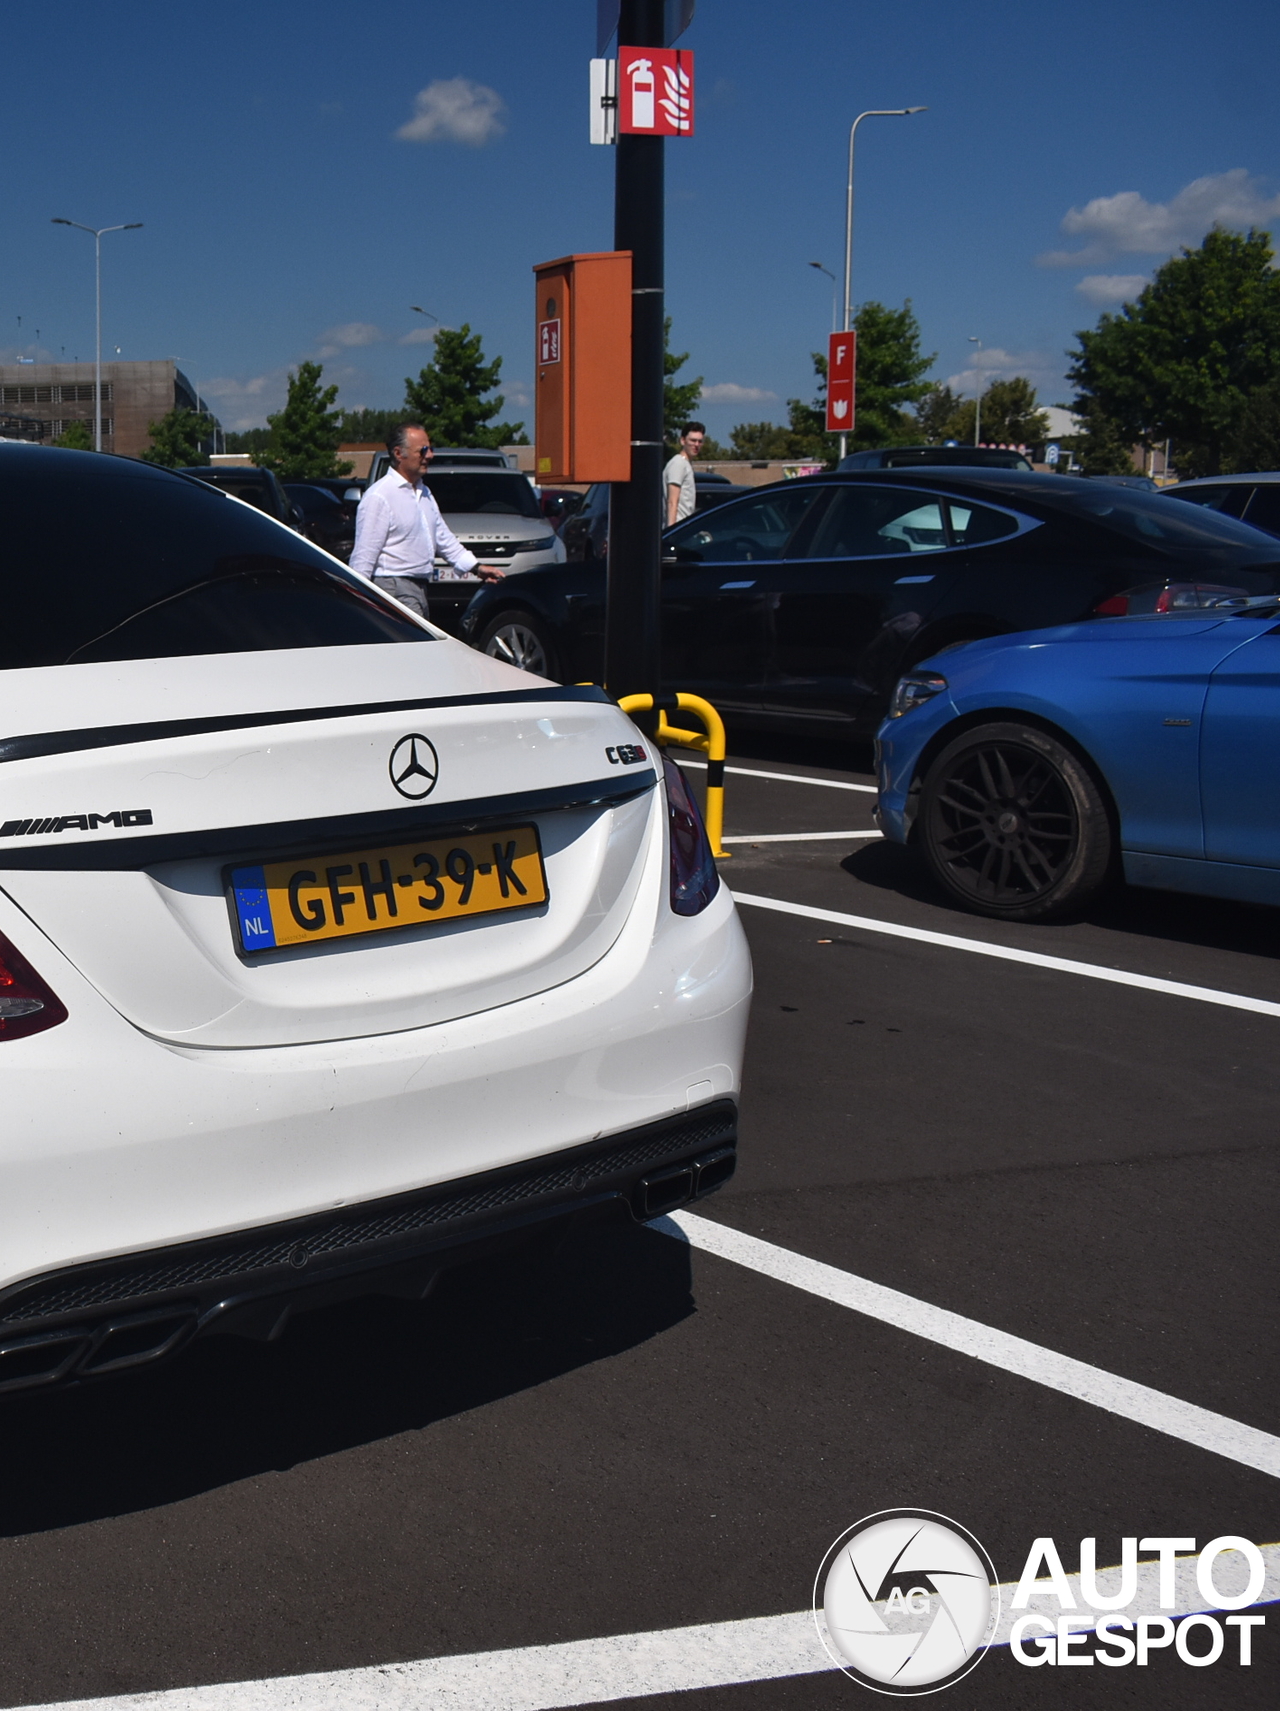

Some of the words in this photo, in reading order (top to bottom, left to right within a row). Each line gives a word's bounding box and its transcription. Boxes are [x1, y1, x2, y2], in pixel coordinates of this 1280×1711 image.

[836, 345, 847, 366] F
[53, 809, 153, 833] AMG
[287, 840, 528, 932] GFH-39-K
[245, 916, 269, 937] NL
